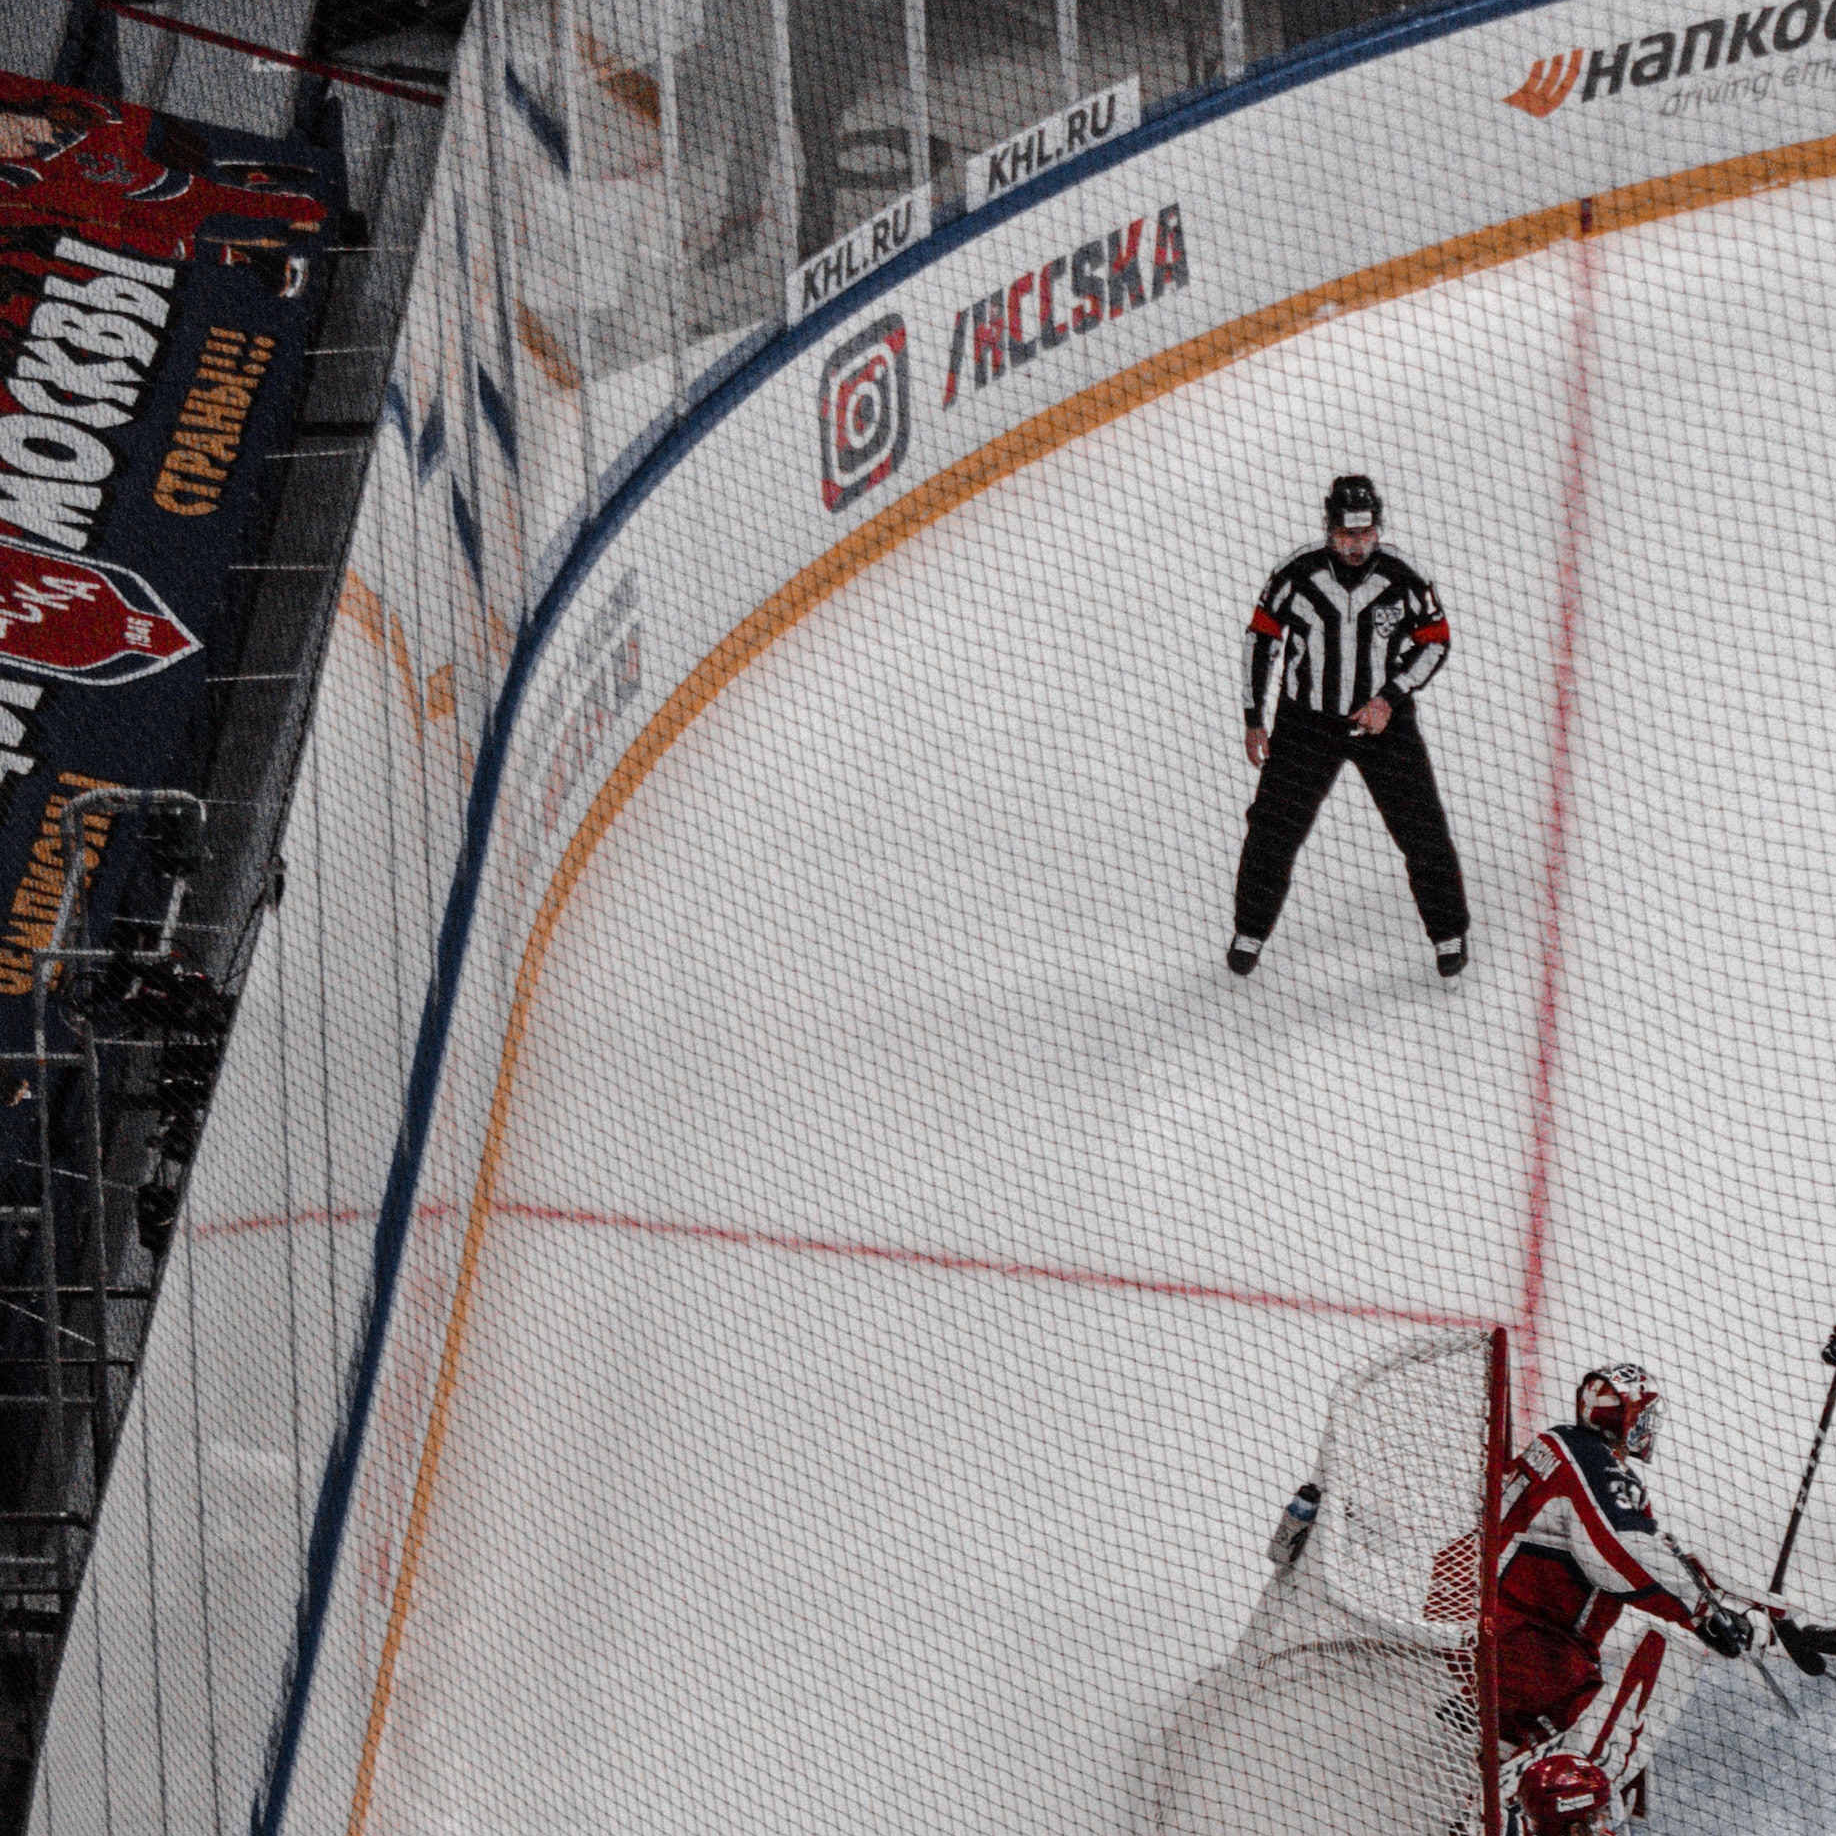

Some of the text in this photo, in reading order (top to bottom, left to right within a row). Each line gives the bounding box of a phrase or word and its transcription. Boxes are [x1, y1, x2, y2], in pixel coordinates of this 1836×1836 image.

[988, 93, 1117, 193] KHL.RU
[1659, 71, 1772, 117] driving
[801, 202, 913, 310] KHL.RU
[0, 236, 178, 552] МОСКВЫ
[151, 326, 276, 518] СТРАНЫ!!!
[0, 573, 101, 640] СКА
